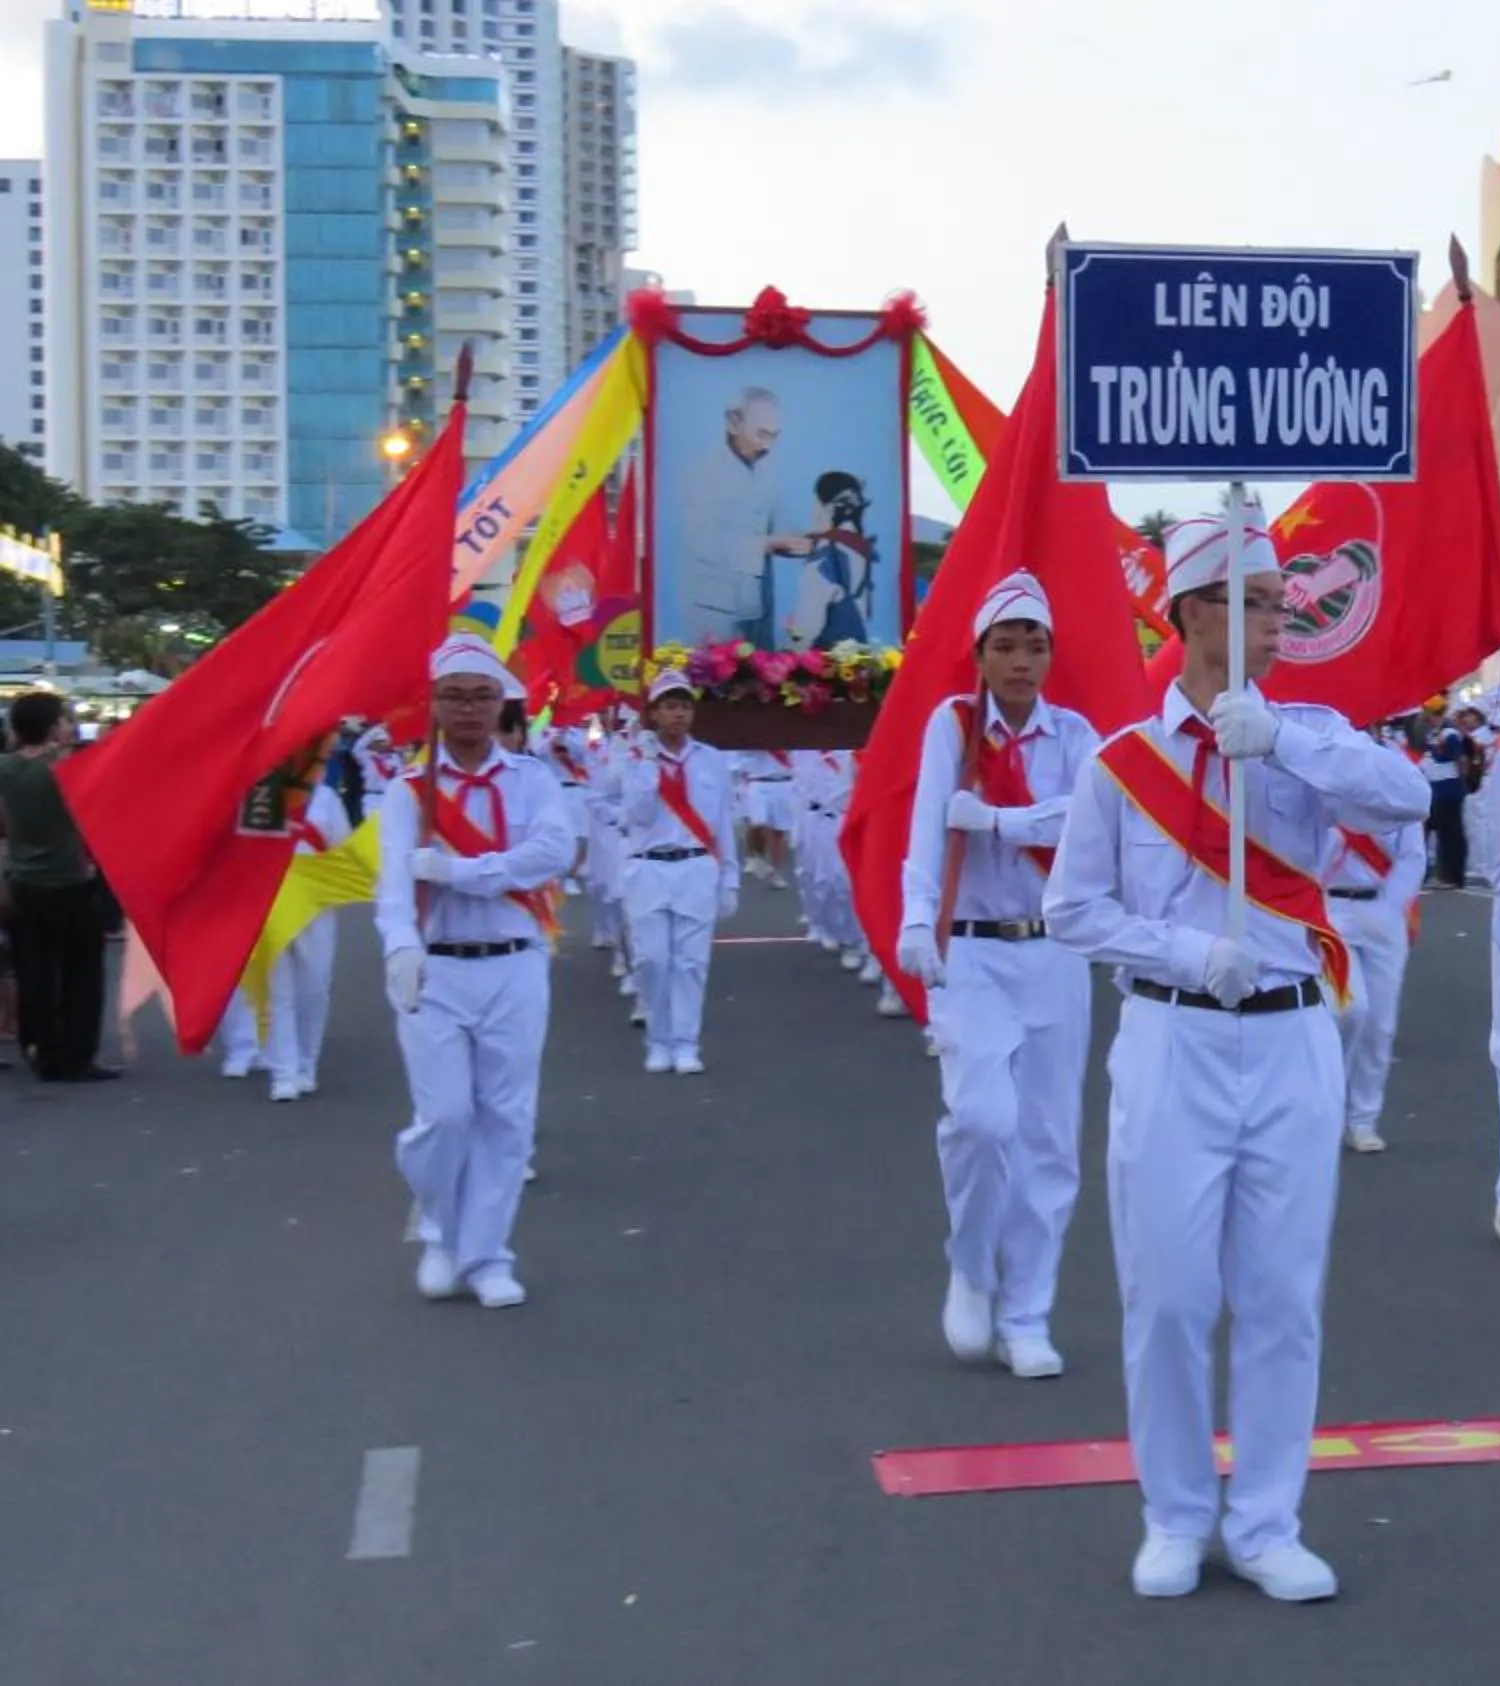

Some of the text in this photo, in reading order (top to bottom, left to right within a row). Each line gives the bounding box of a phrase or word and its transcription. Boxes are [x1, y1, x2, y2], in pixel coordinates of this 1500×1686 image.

[1154, 271, 1331, 337] LIÊN ĐỘI
[1090, 349, 1389, 447] TRƯNG VƯƠNG
[456, 496, 513, 554] TỐT
